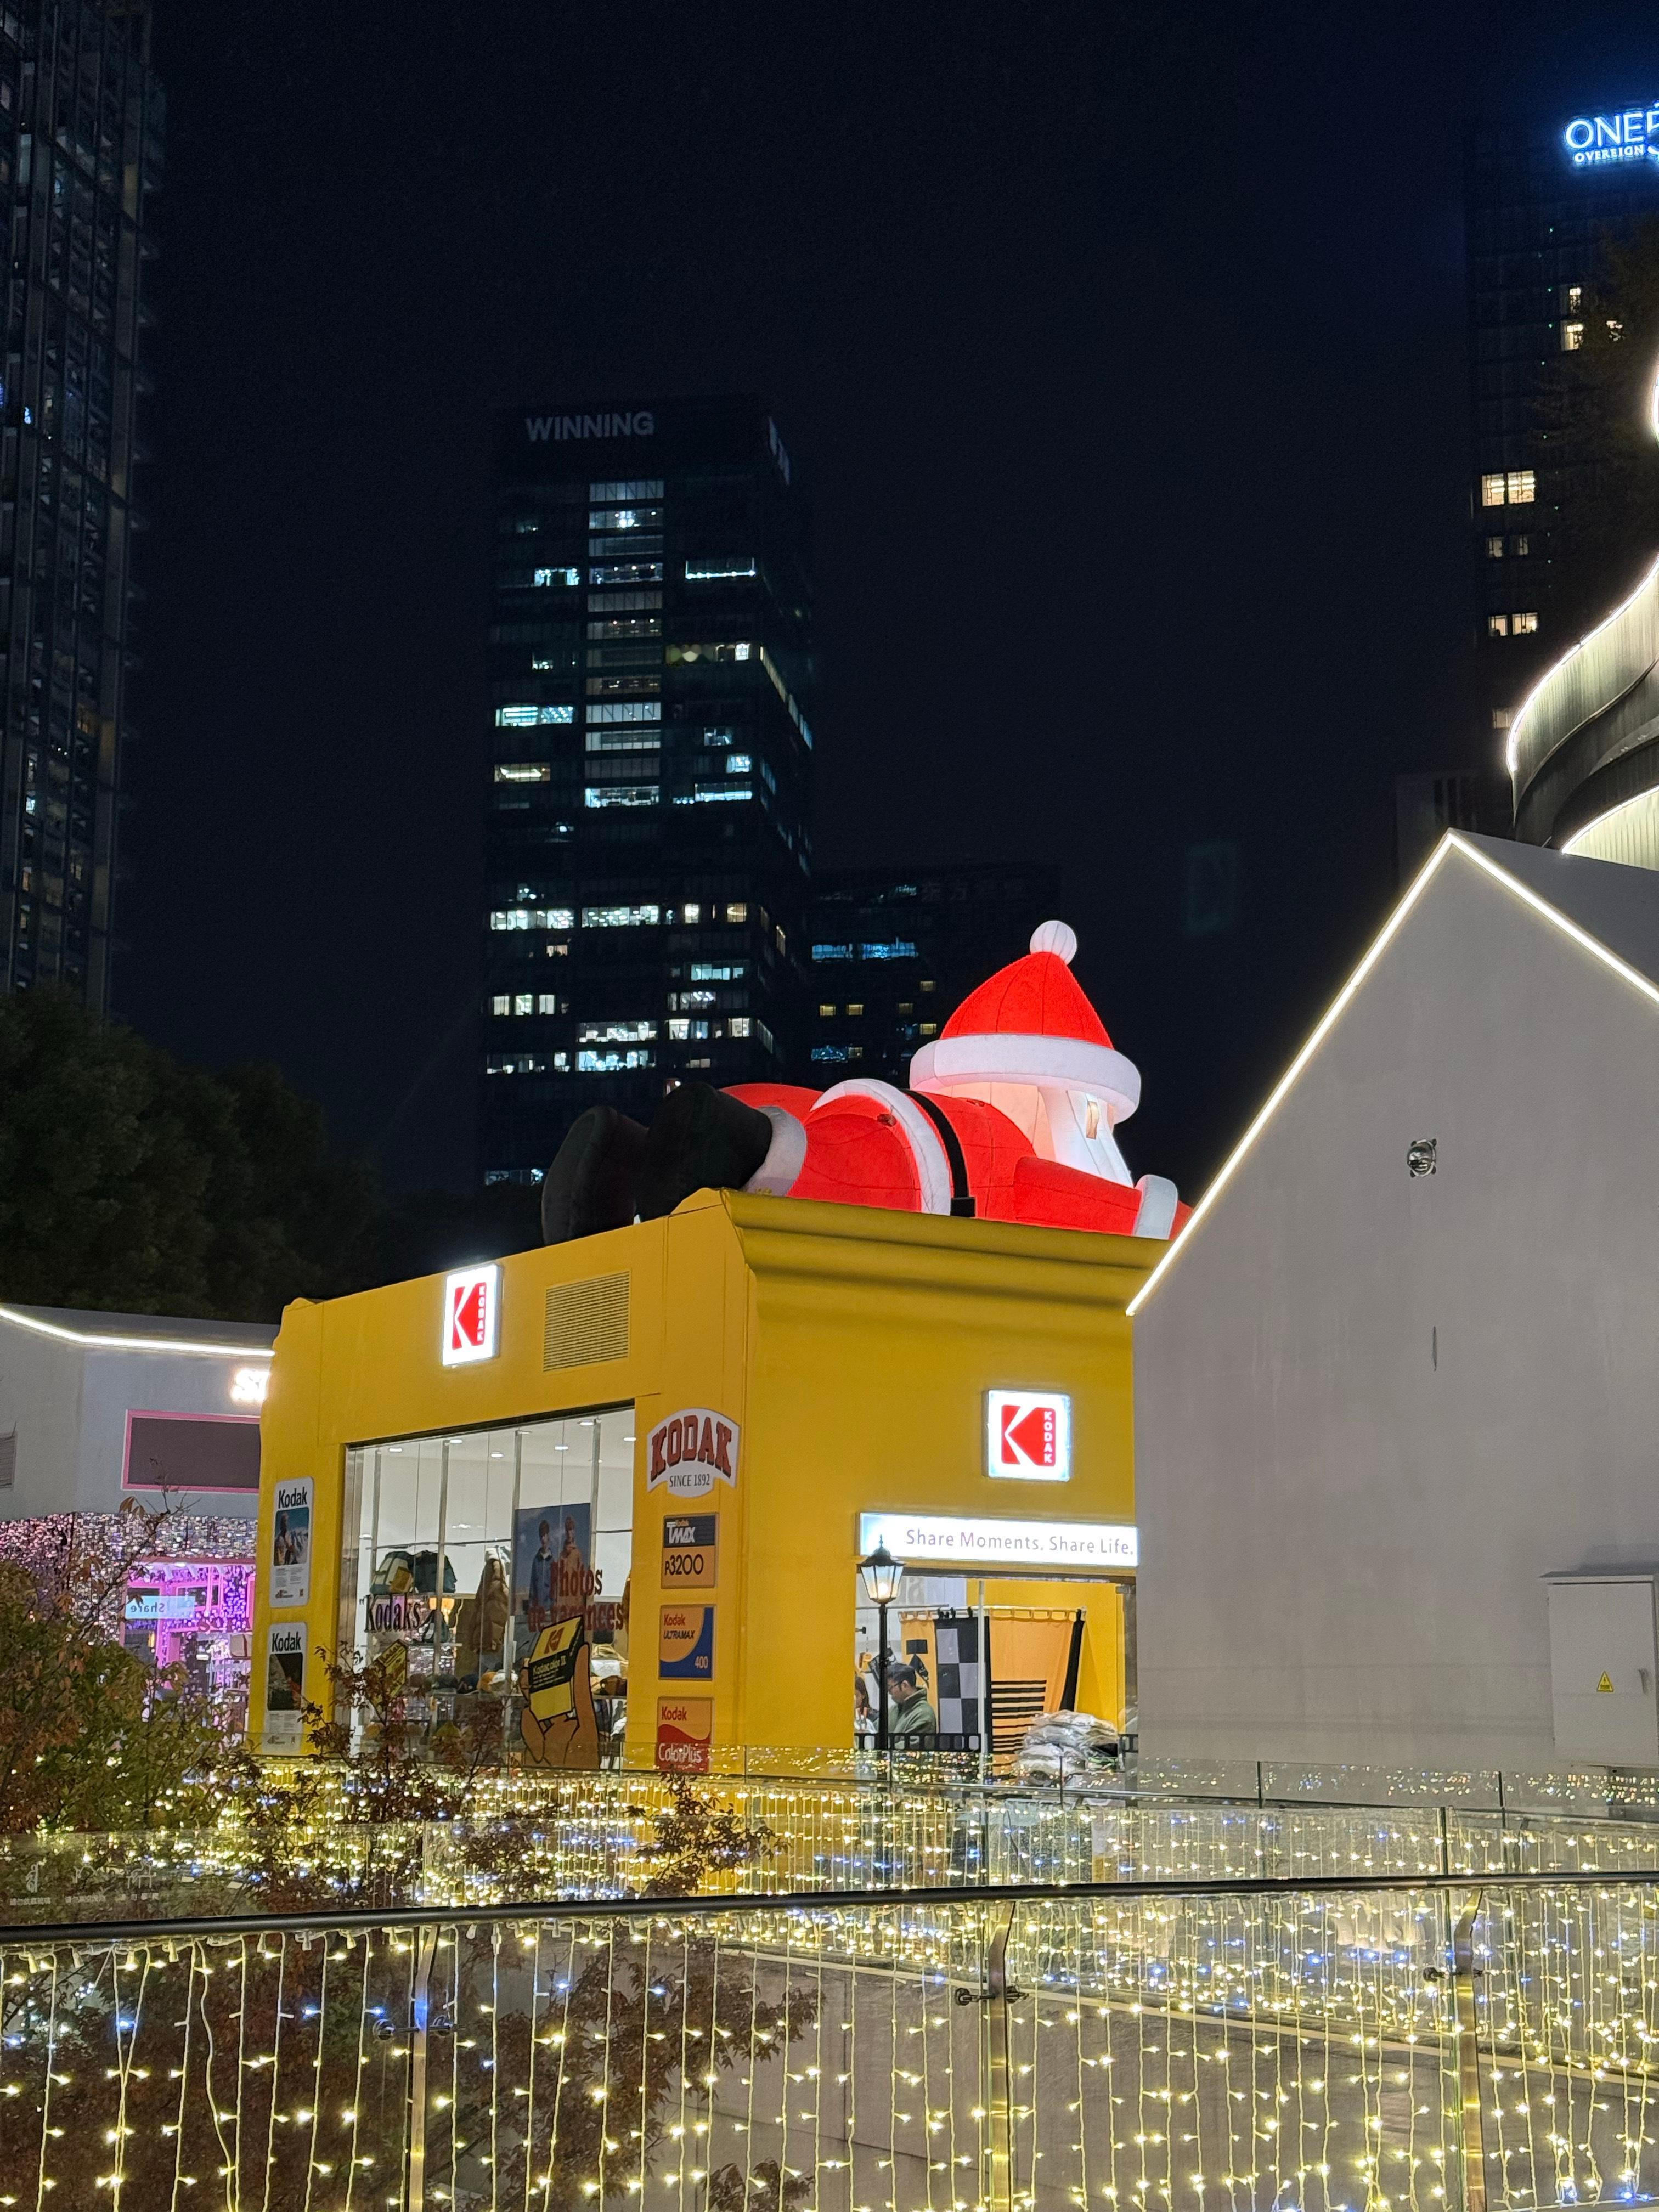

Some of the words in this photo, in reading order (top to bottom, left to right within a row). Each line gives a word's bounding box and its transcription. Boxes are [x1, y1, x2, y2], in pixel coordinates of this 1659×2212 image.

[526, 411, 656, 441] WINNING
[476, 1285, 485, 1342] KODAK
[1043, 1410, 1053, 1463] KODAK
[651, 1415, 732, 1483] KODAK
[669, 1474, 692, 1487] SINCE
[694, 1474, 710, 1487] 1892
[278, 1486, 308, 1509] Kodak
[906, 1529, 954, 1546] Share
[1049, 1536, 1095, 1553] Share
[1101, 1538, 1134, 1555] Life.
[663, 1614, 685, 1626] Kodak
[271, 1632, 302, 1652] Kodak
[663, 1630, 695, 1639] ULTRAMAX
[695, 1656, 708, 1669] 400
[662, 1706, 687, 1721] Kodak
[658, 1743, 703, 1764] ColorPlus
